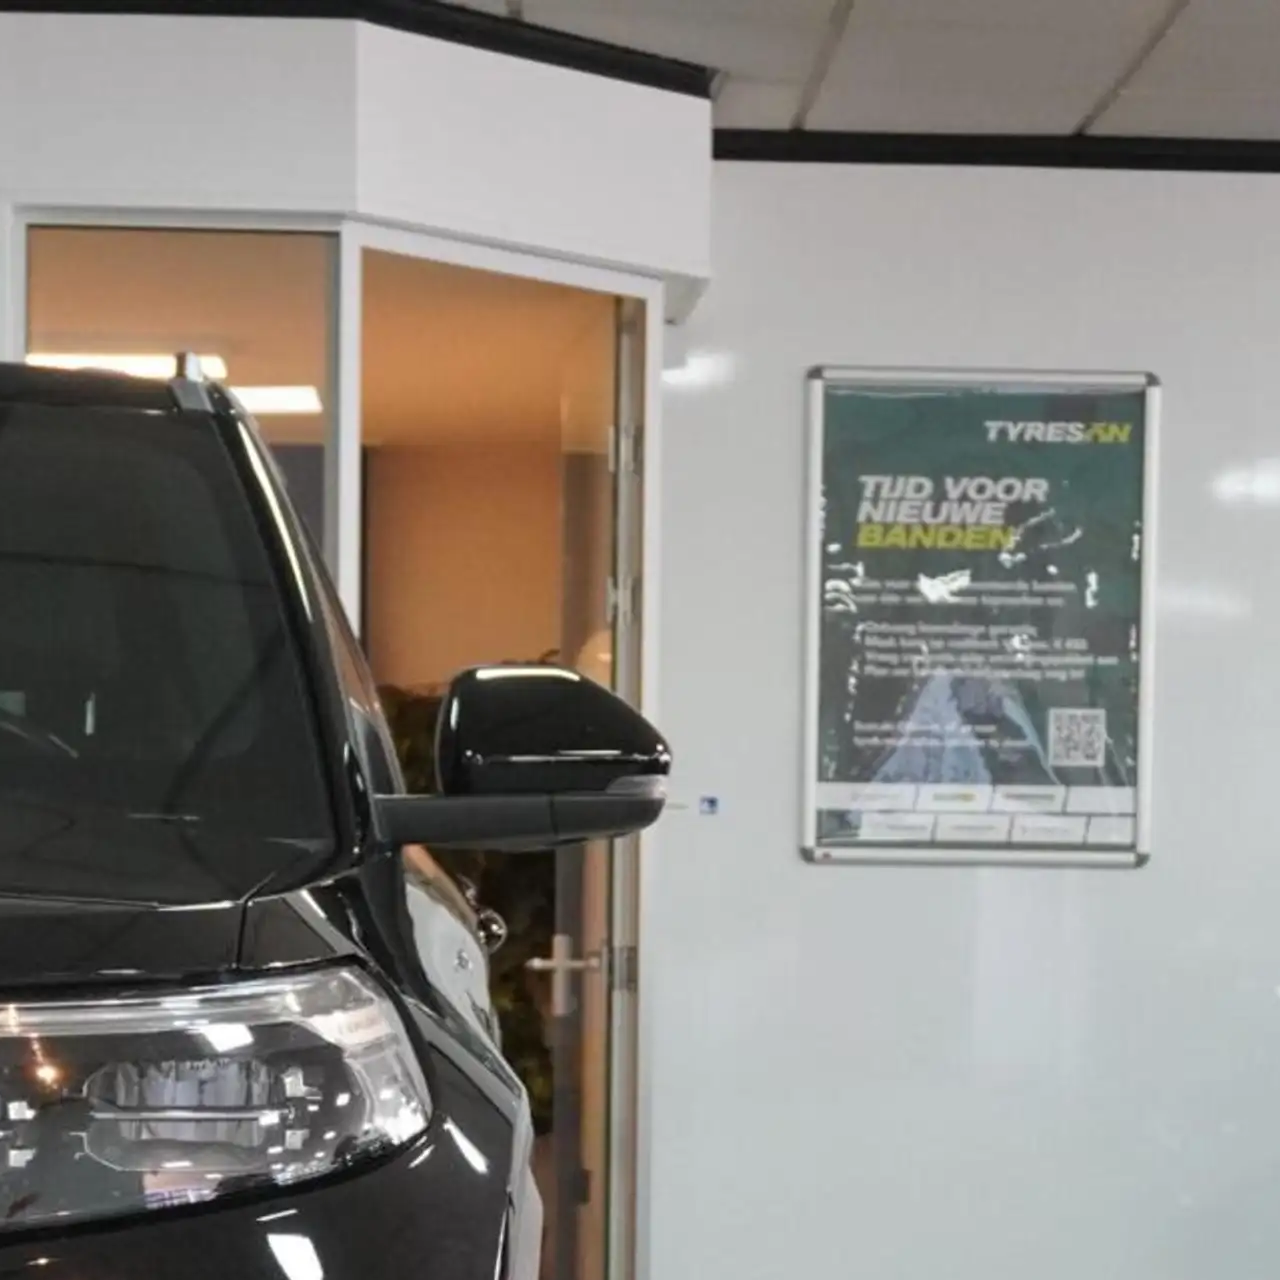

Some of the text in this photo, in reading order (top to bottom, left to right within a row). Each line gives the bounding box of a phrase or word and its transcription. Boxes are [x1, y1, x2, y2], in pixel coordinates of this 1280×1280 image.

[945, 476, 1050, 503] VOOR
[856, 501, 1008, 526] NIEUWE
[855, 523, 1016, 551] BANDEN
